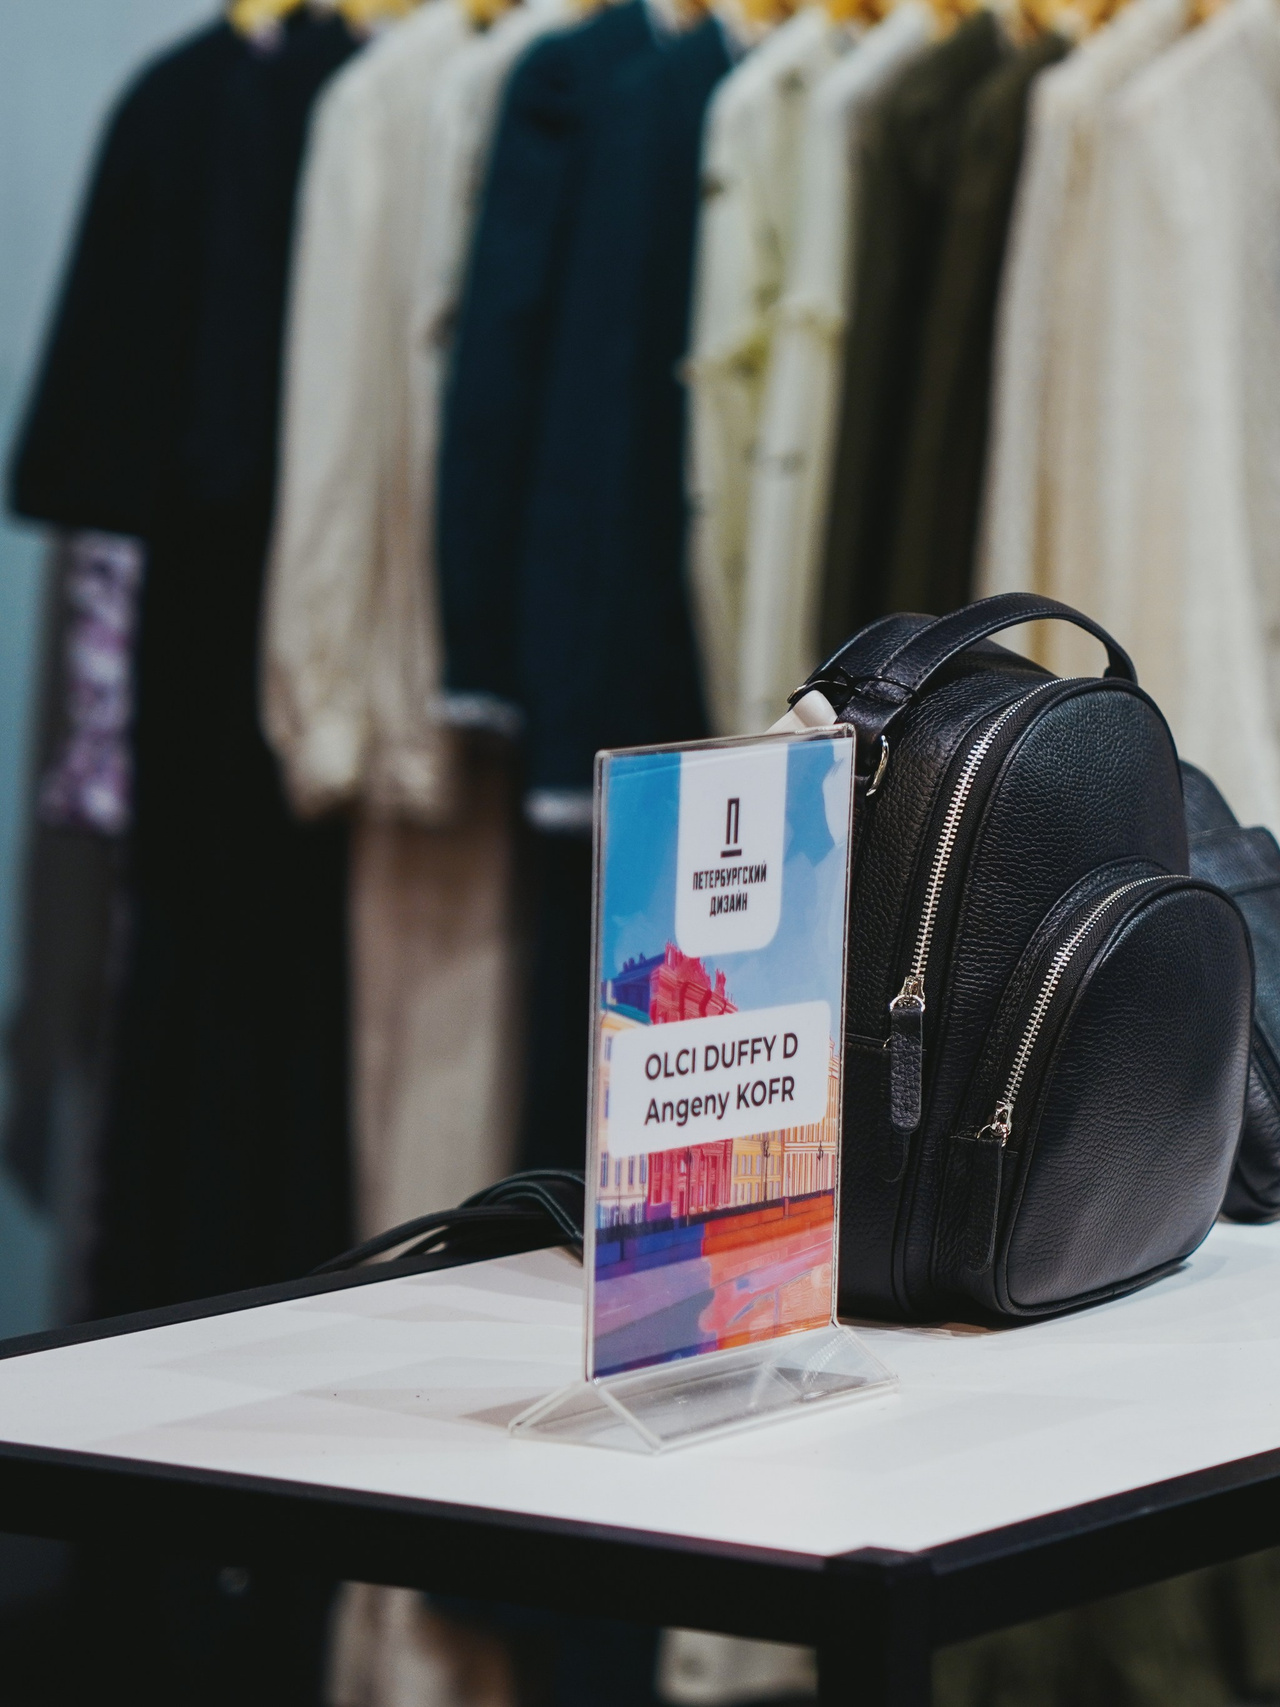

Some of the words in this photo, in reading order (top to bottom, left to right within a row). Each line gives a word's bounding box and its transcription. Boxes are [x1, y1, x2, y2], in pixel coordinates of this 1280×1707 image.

[692, 861, 767, 891] ПЕТЕРБУРГСКИЙ
[709, 890, 748, 917] ДИЗАЙН
[645, 1047, 696, 1080] OLCI
[704, 1035, 777, 1072] DUFFY
[782, 1032, 798, 1060] D
[644, 1090, 730, 1126] Angeny
[735, 1076, 795, 1110] KOFR
